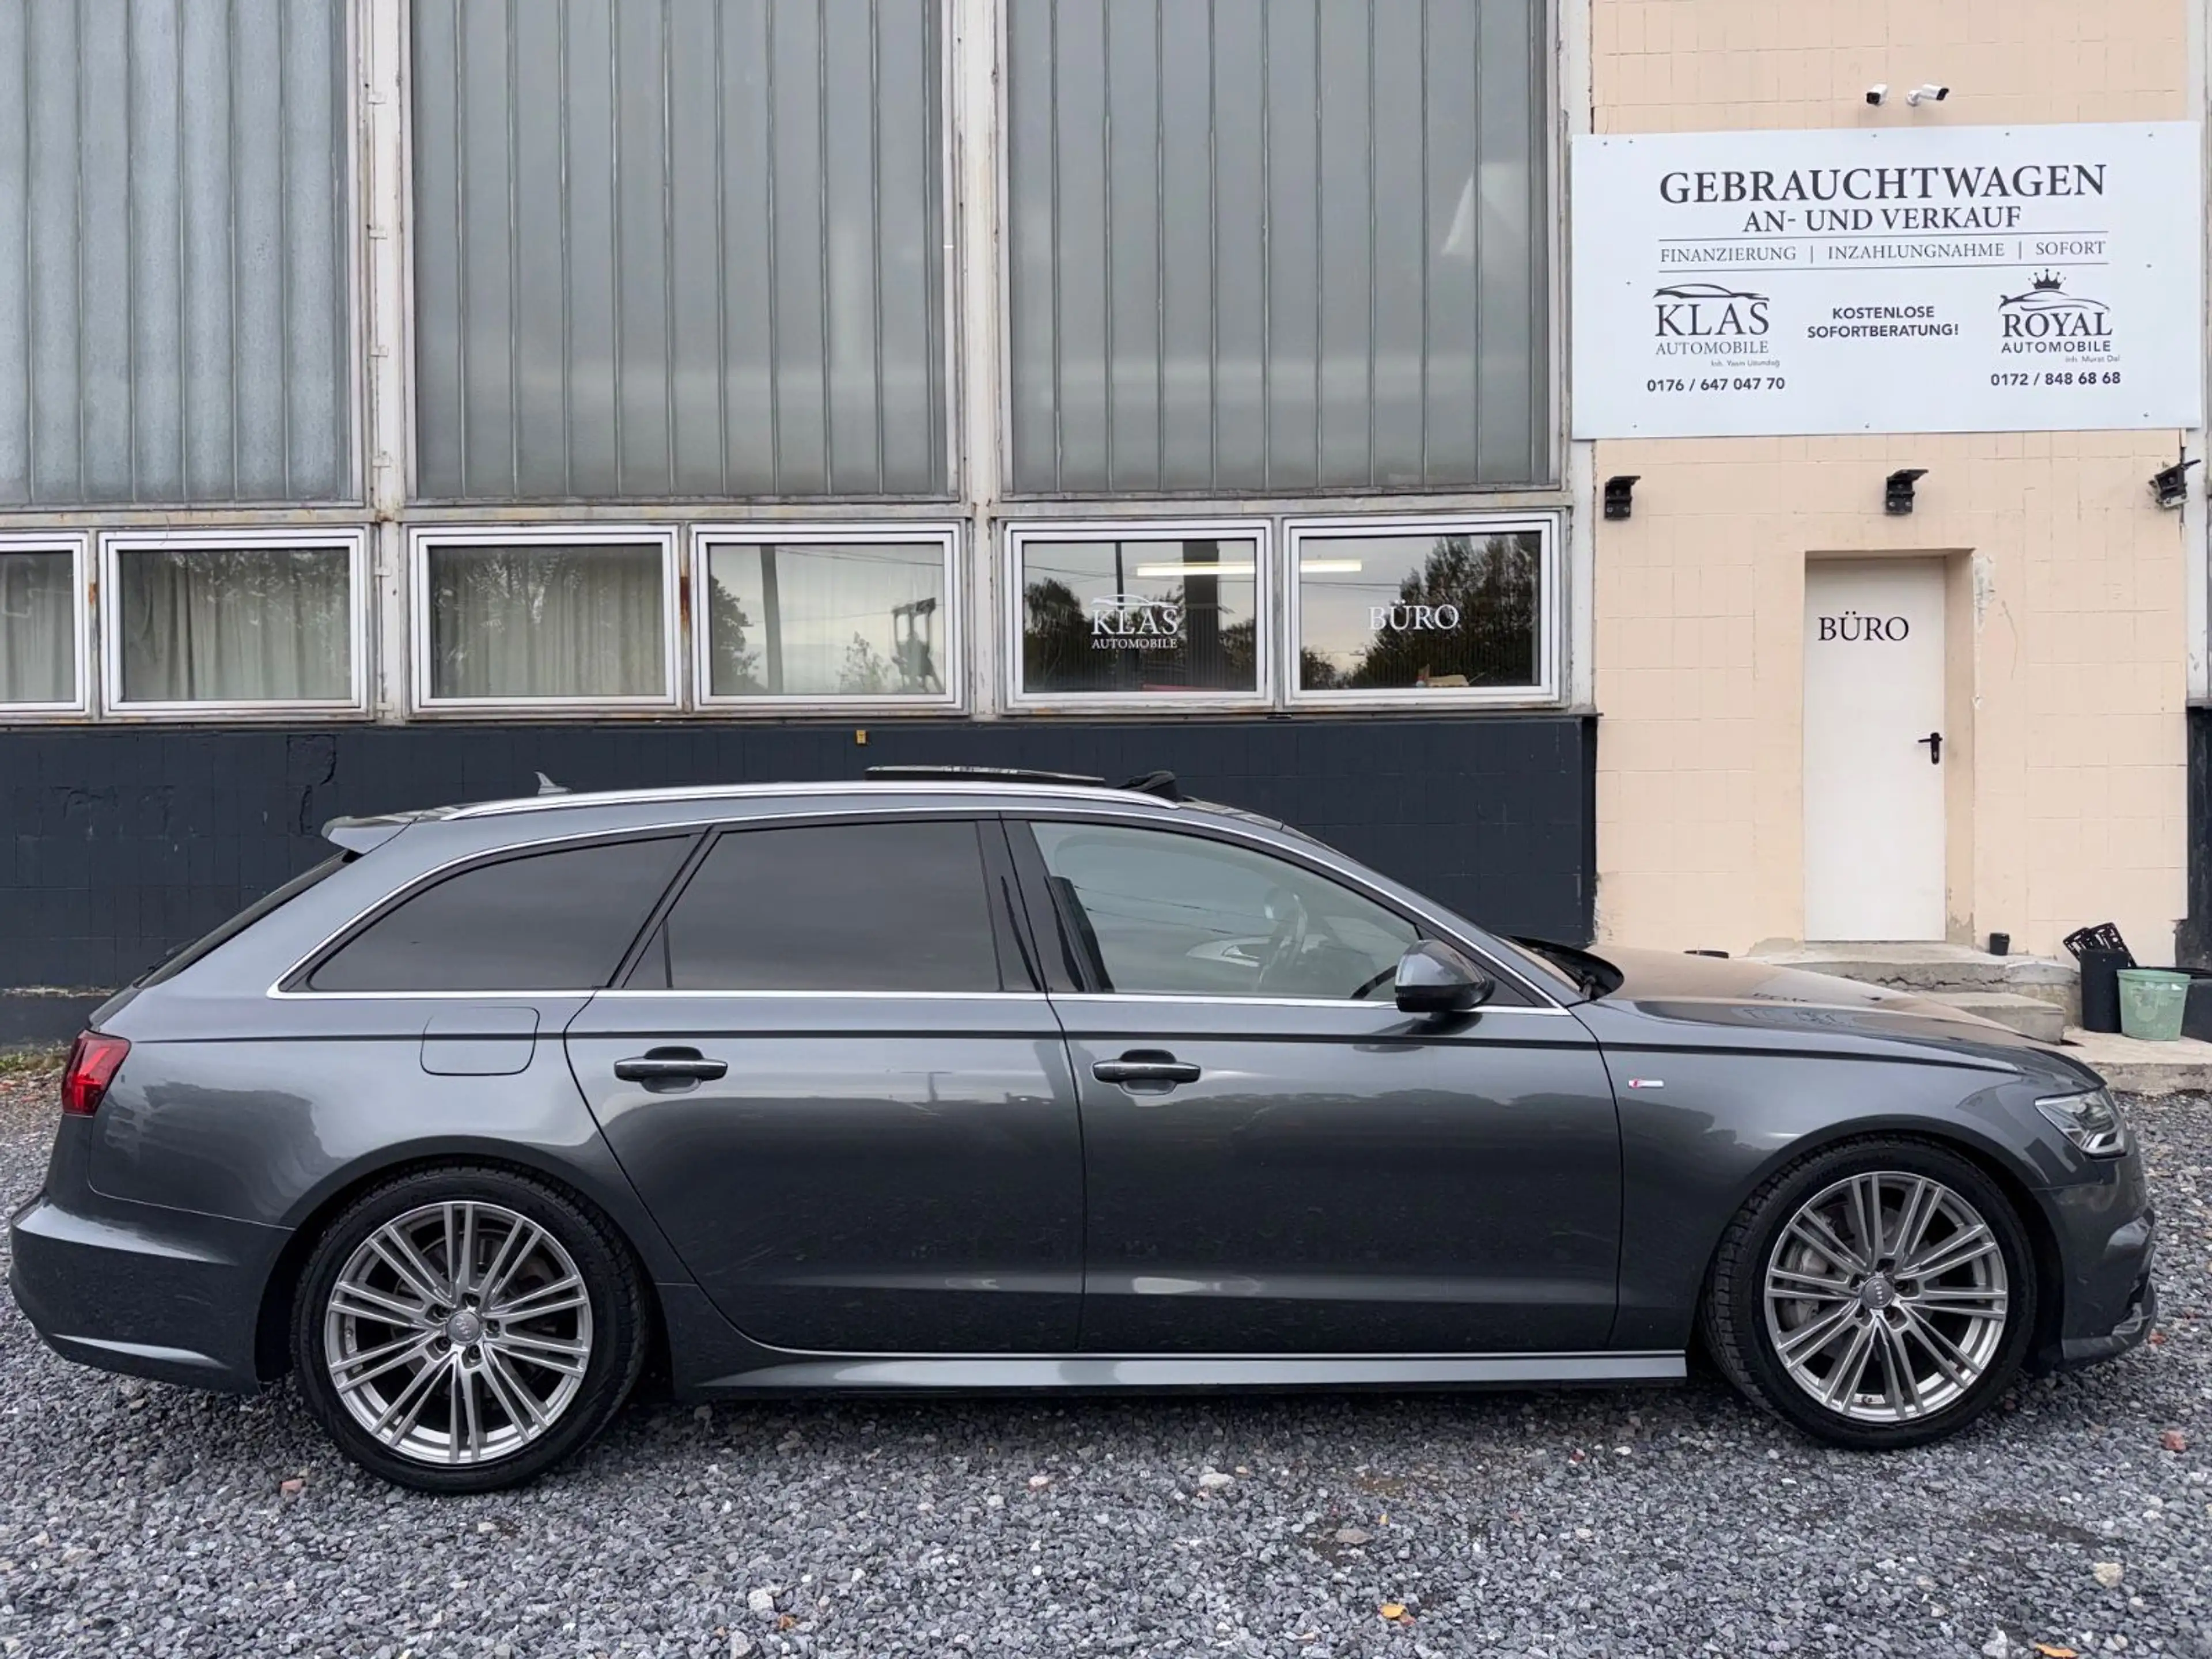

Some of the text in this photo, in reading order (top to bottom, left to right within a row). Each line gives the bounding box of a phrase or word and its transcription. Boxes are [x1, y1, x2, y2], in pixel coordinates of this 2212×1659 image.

[1660, 164, 2107, 203] GEBRAUCHTWAGEN
[1743, 206, 2021, 232] AN- UND VERKAUF
[1661, 240, 2106, 263] FINANZIERUNG INZAHLUNGNAHME SOFORT
[1654, 302, 1769, 336] KLAS
[1832, 305, 1935, 319] KOSTENLOSE
[1807, 324, 1959, 339] SOFORTBERATUNG!
[2002, 312, 2113, 338] ROYAL
[1656, 340, 1768, 355] AUTOMOBILE
[2001, 340, 2111, 353] AUTOMOBILE
[1647, 378, 1684, 392] 0176
[1700, 378, 1729, 391] 647
[1733, 377, 1762, 391] 047
[1767, 377, 1785, 390] 70
[1991, 373, 2029, 387] 0172
[2045, 372, 2073, 385] 848
[2078, 372, 2097, 385] 68
[2102, 372, 2121, 385] 68
[1091, 609, 1179, 635] KLAS
[1368, 599, 1460, 630] BÜRO
[1818, 611, 1910, 641] BÜRO
[1092, 638, 1178, 649] AUTOMOBILE
